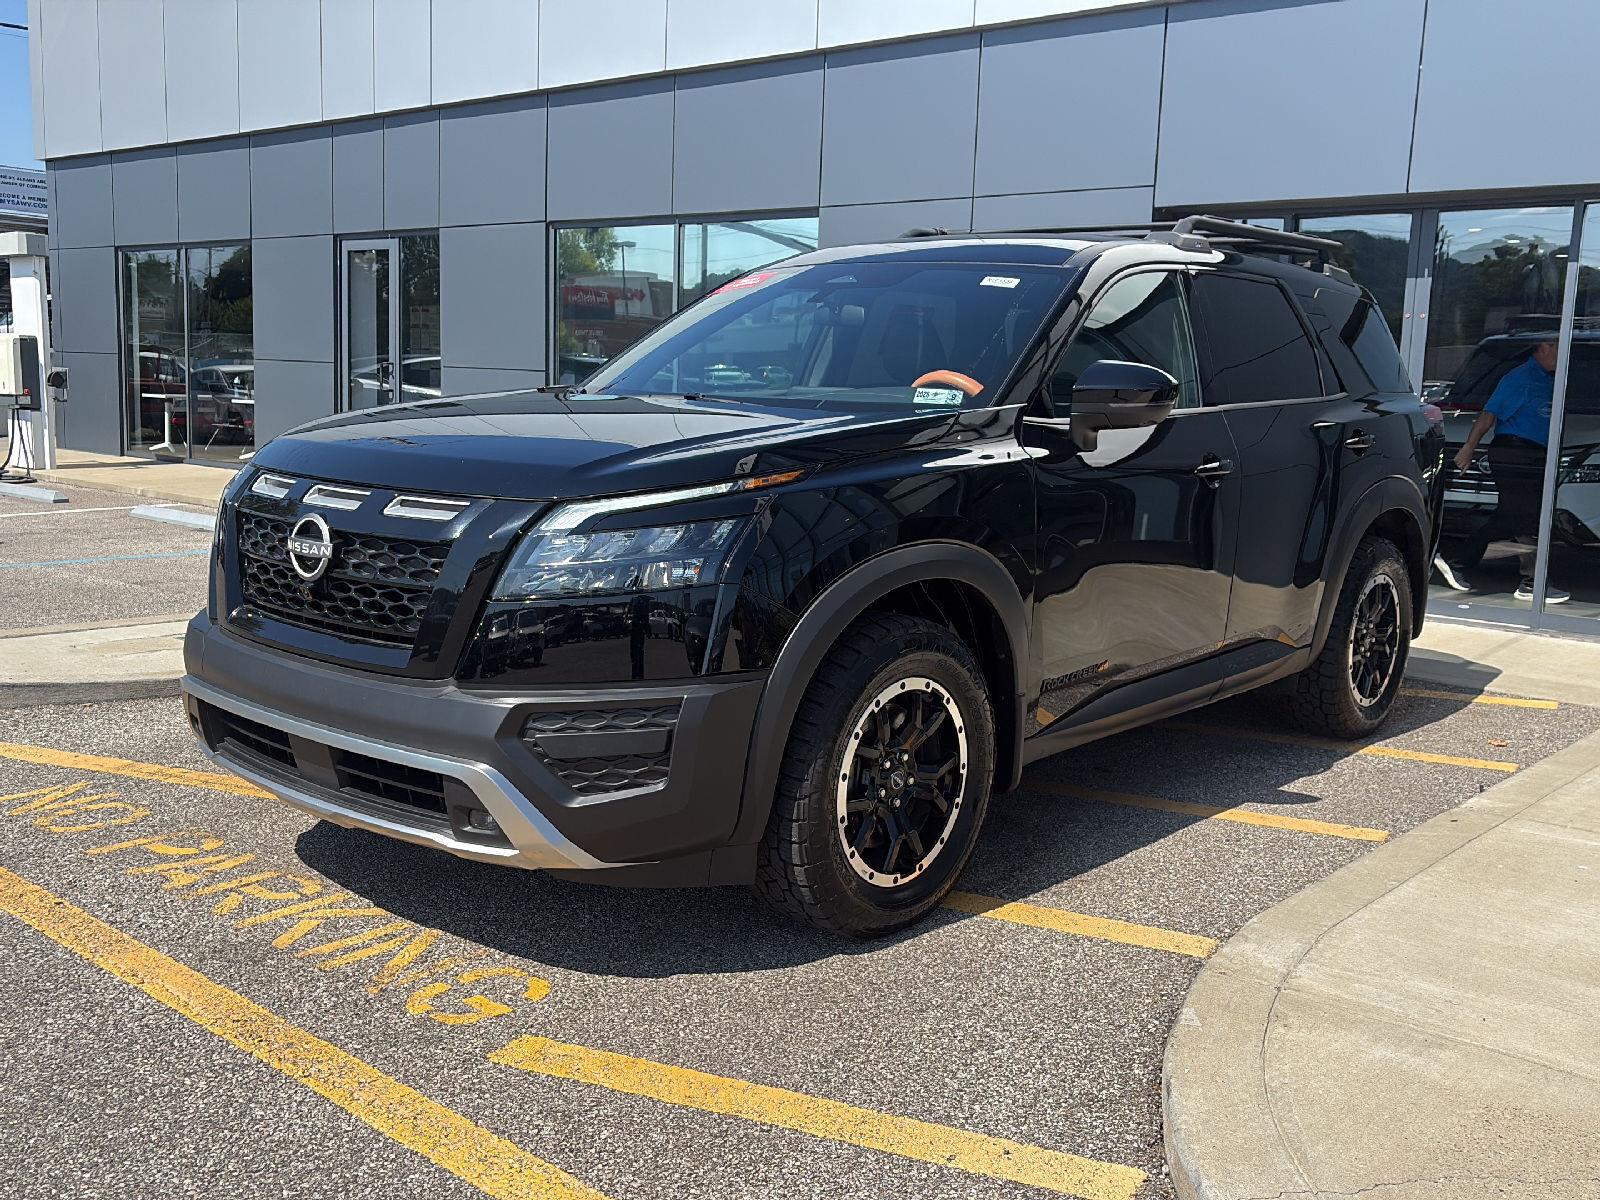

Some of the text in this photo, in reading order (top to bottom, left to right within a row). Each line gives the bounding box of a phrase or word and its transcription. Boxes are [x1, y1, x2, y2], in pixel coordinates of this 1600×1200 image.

[287, 538, 331, 556] NISSAN
[1041, 675, 1071, 691] ROCK
[0, 780, 550, 1026] NO PARKING
